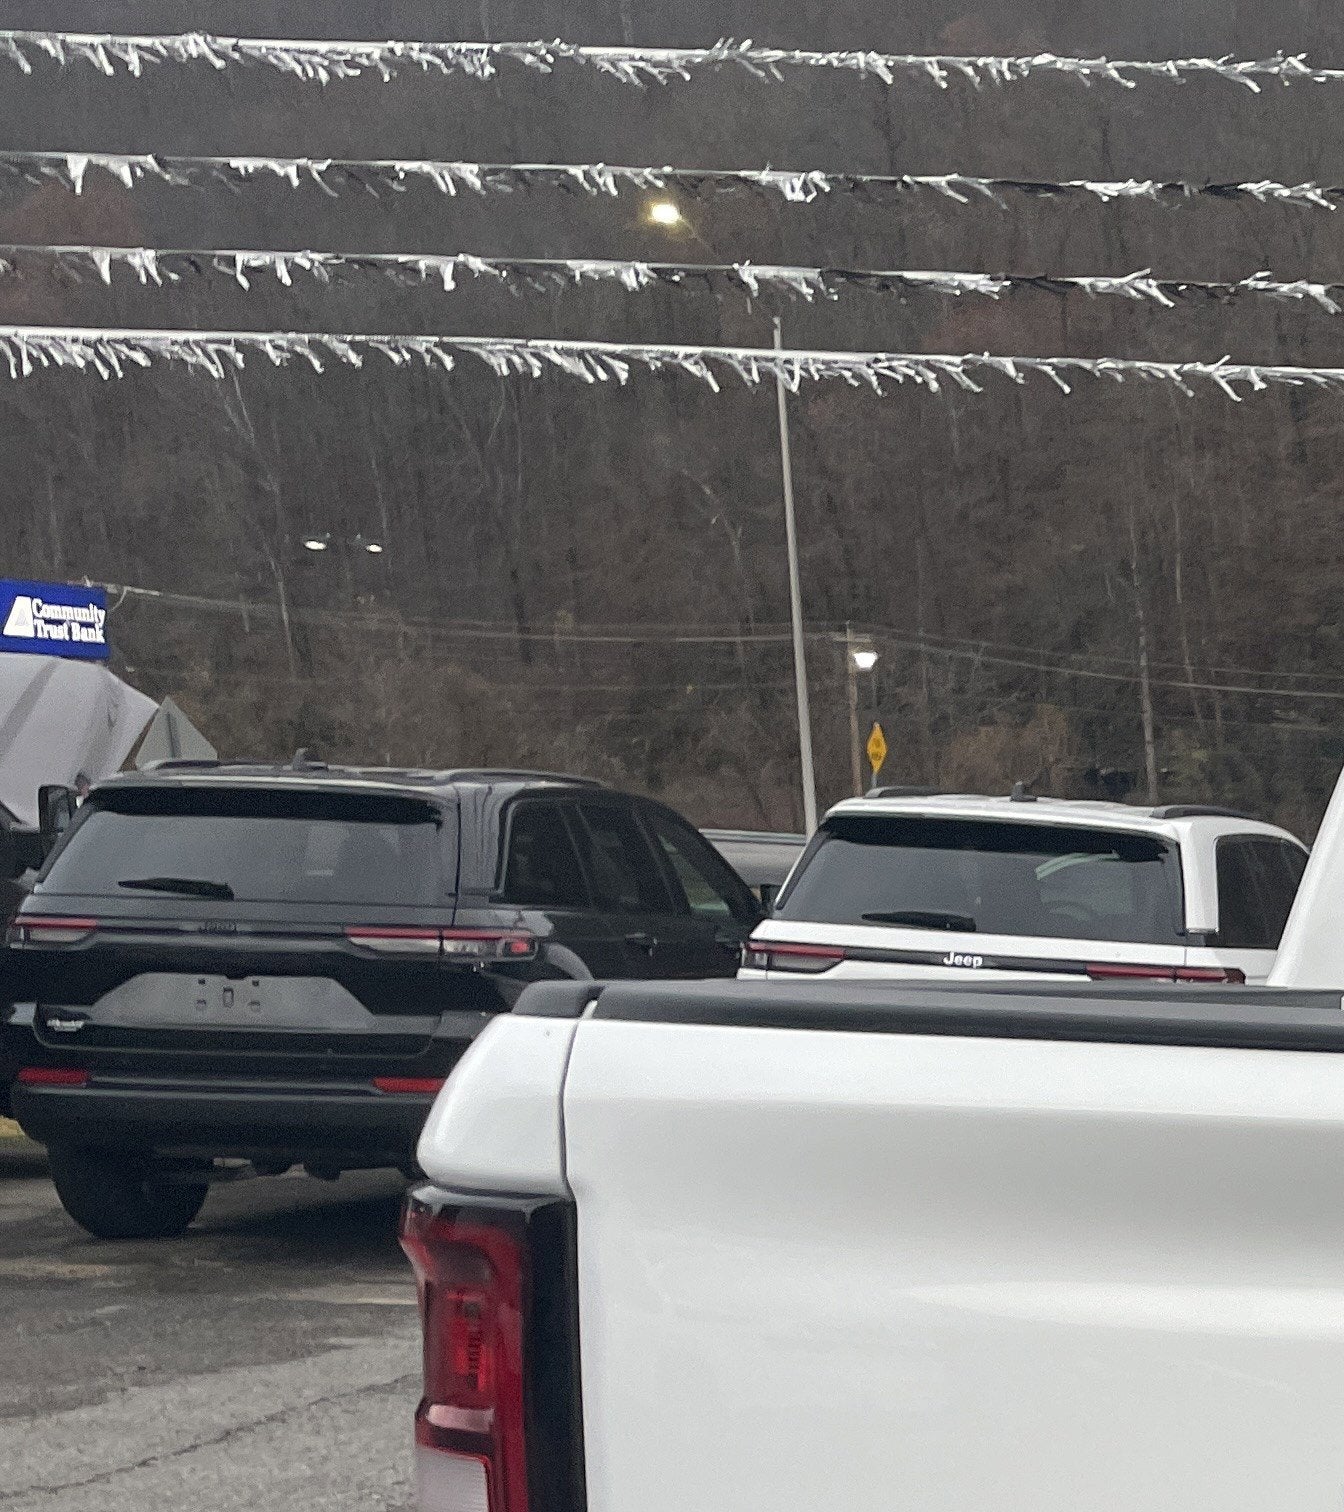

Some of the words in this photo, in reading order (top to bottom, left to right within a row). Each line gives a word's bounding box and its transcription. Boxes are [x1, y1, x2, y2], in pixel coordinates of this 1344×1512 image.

[32, 598, 106, 628] Community
[33, 618, 70, 641] Trust
[71, 621, 105, 643] Bank
[943, 951, 983, 969] Jeep
